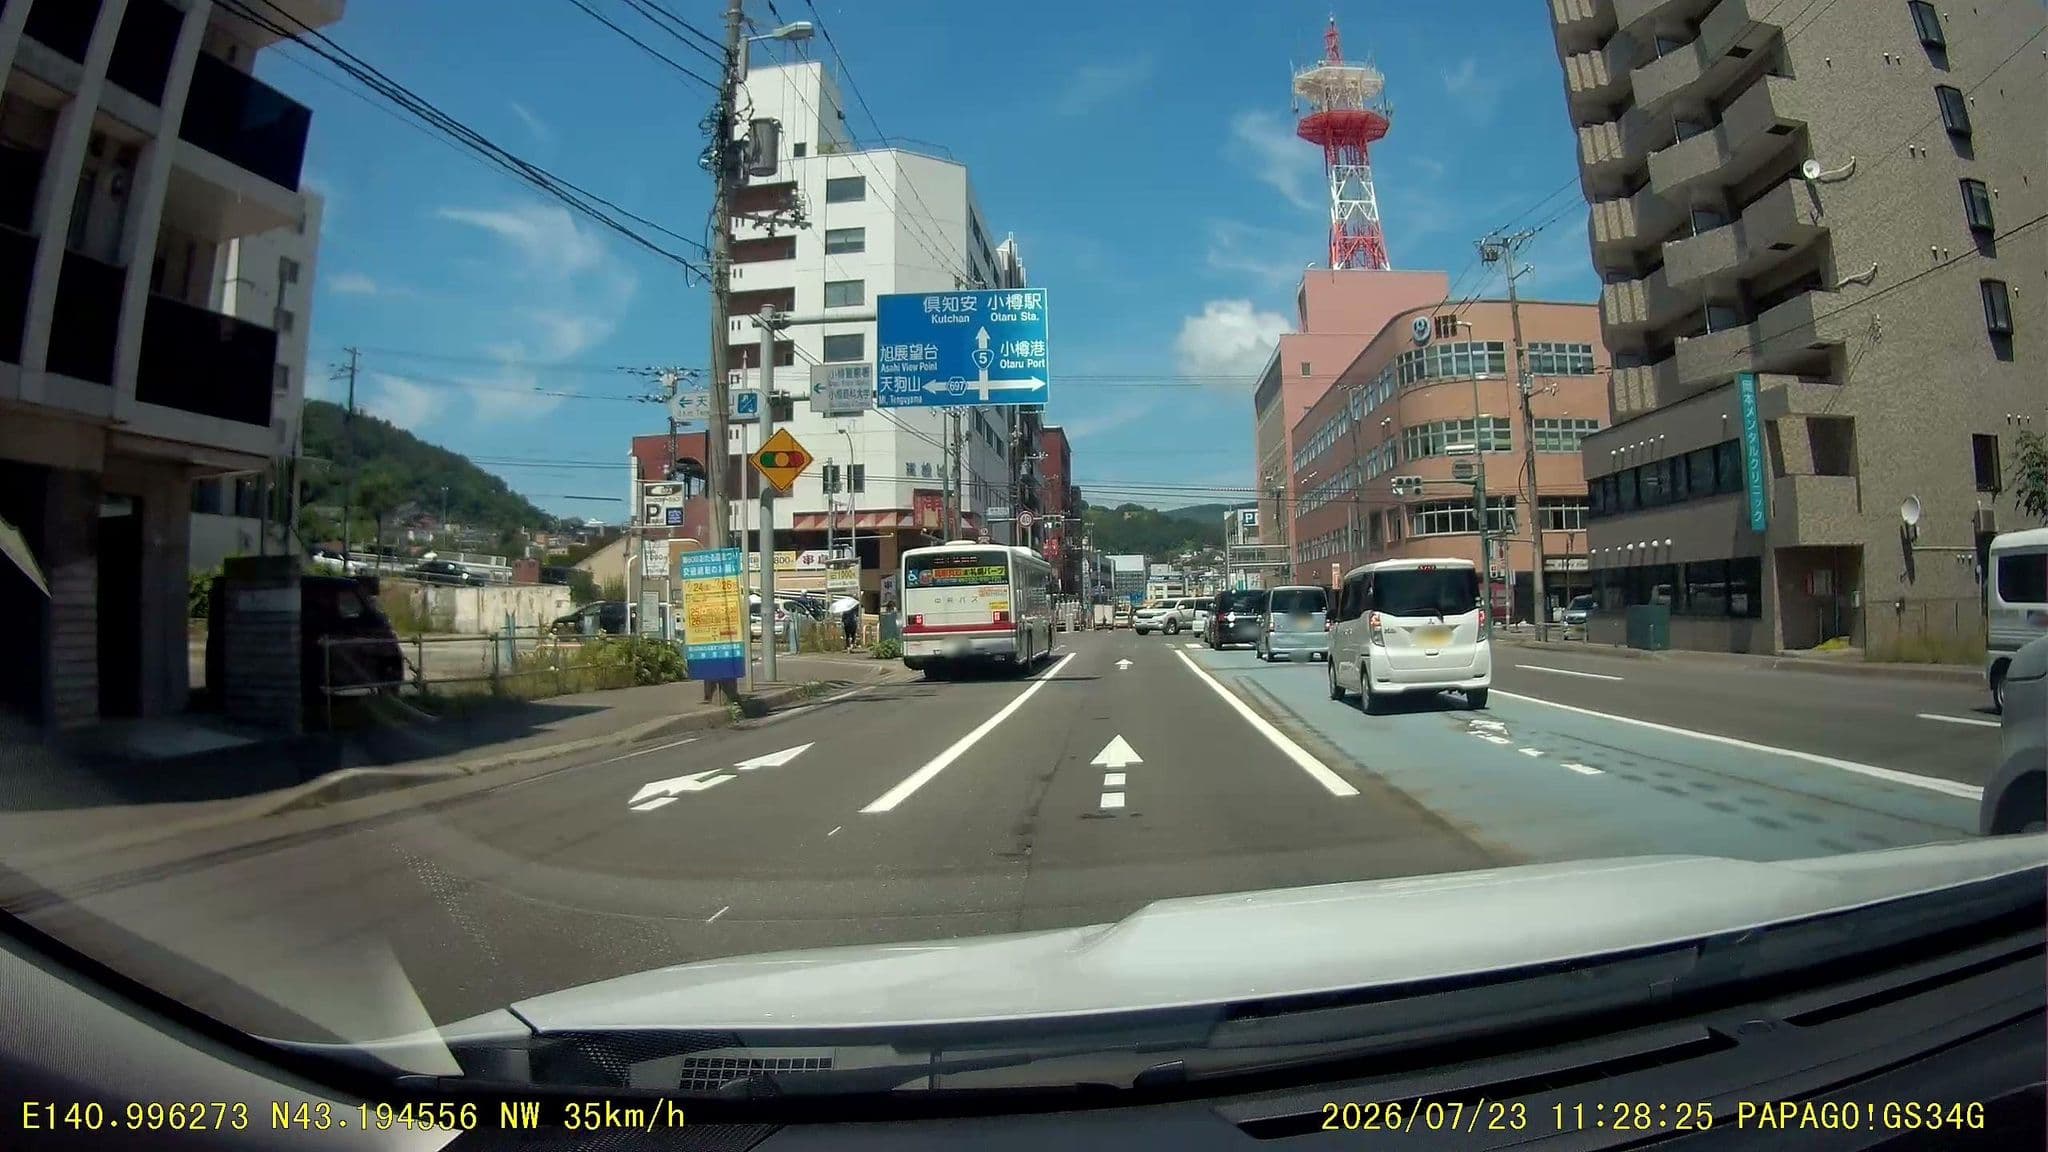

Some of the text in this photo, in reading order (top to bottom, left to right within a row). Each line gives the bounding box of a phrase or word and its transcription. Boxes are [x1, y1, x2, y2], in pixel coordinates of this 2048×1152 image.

[923, 296, 977, 313] 倶知安
[987, 293, 1042, 310] 小樽駅
[931, 314, 969, 324] Kutchan
[990, 311, 1039, 322] Otaru Sta.
[880, 344, 938, 362] 旭展望台
[1000, 341, 1045, 357] 小樽港
[978, 352, 988, 364] 5
[1000, 357, 1045, 369] Otaru Port
[920, 361, 937, 372] Point
[880, 376, 920, 393] 天狗山
[950, 381, 965, 391] 697
[646, 503, 661, 524] P
